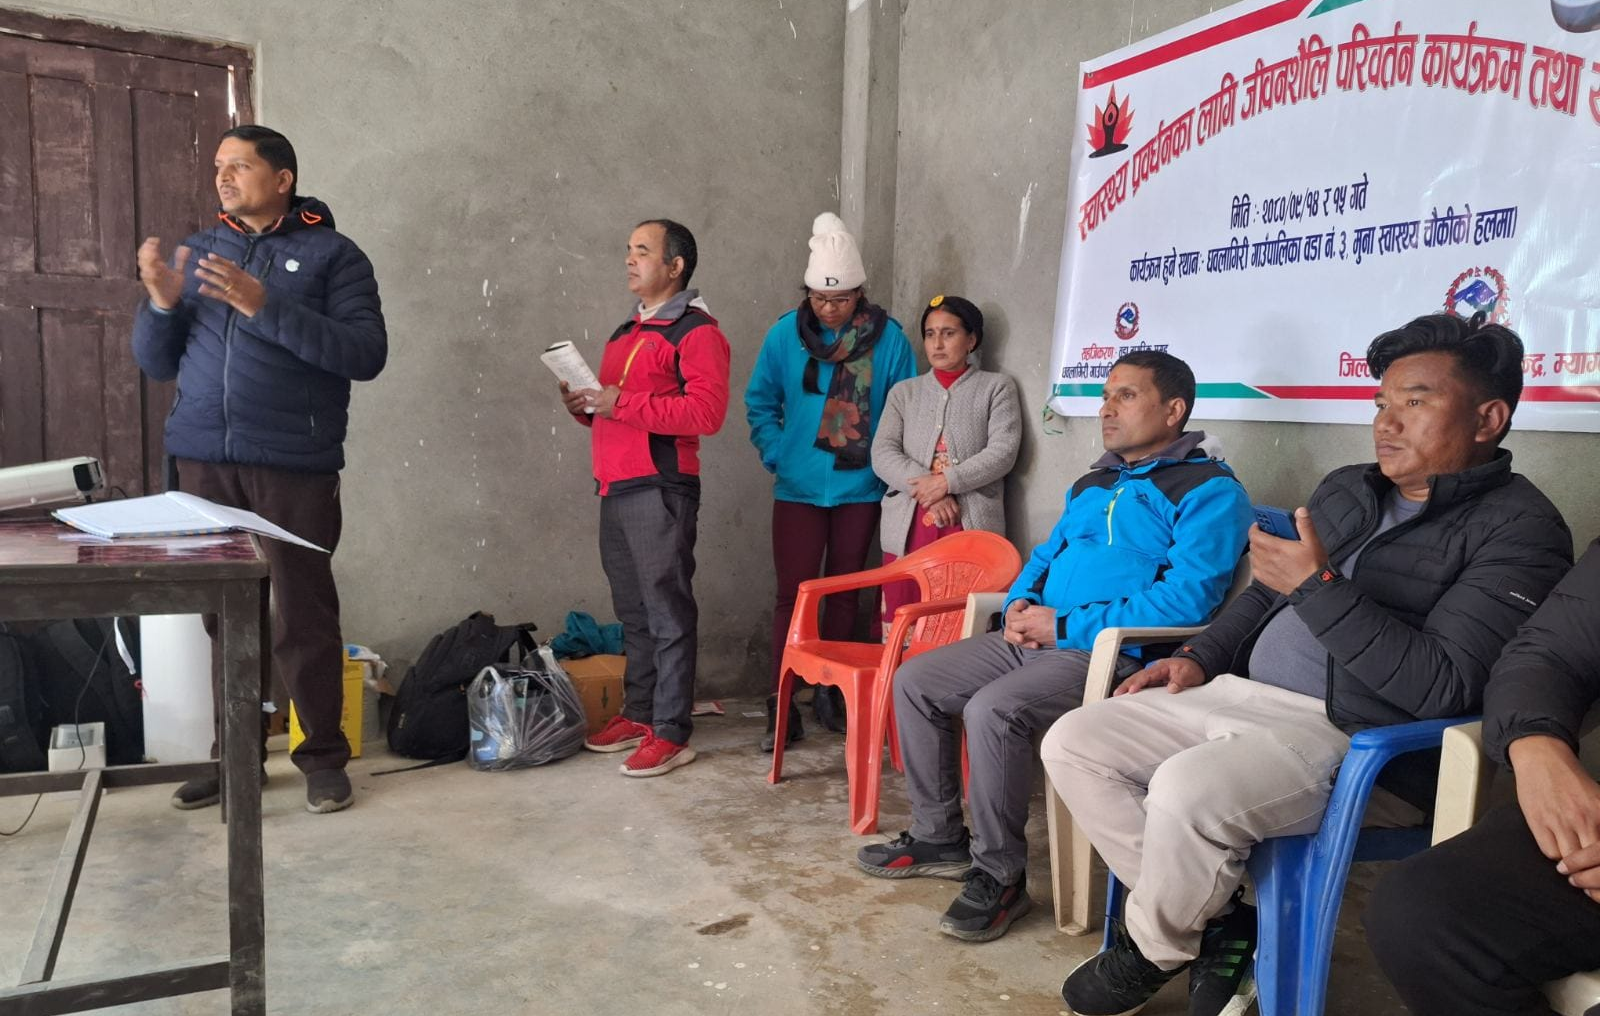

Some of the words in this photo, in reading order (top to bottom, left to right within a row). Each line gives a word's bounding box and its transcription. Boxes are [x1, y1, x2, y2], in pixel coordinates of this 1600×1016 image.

[1197, 72, 1239, 146] लागि
[1336, 21, 1419, 92] परिवर्तन
[1421, 21, 1526, 99] कार्यक्रम
[1528, 45, 1585, 116] तथा
[1231, 193, 1251, 229] मिति
[1323, 188, 1332, 216] र
[1349, 172, 1368, 211] गते
[1130, 252, 1162, 282] कार्यक्रम
[1163, 247, 1177, 285] हुने
[1304, 234, 1323, 261] वडा
[1353, 227, 1376, 265] मुना
[1424, 203, 1472, 247] चौकीको
[825, 277, 839, 287] D
[1339, 351, 1370, 378] जिल्
[1553, 352, 1600, 375] म्याग
